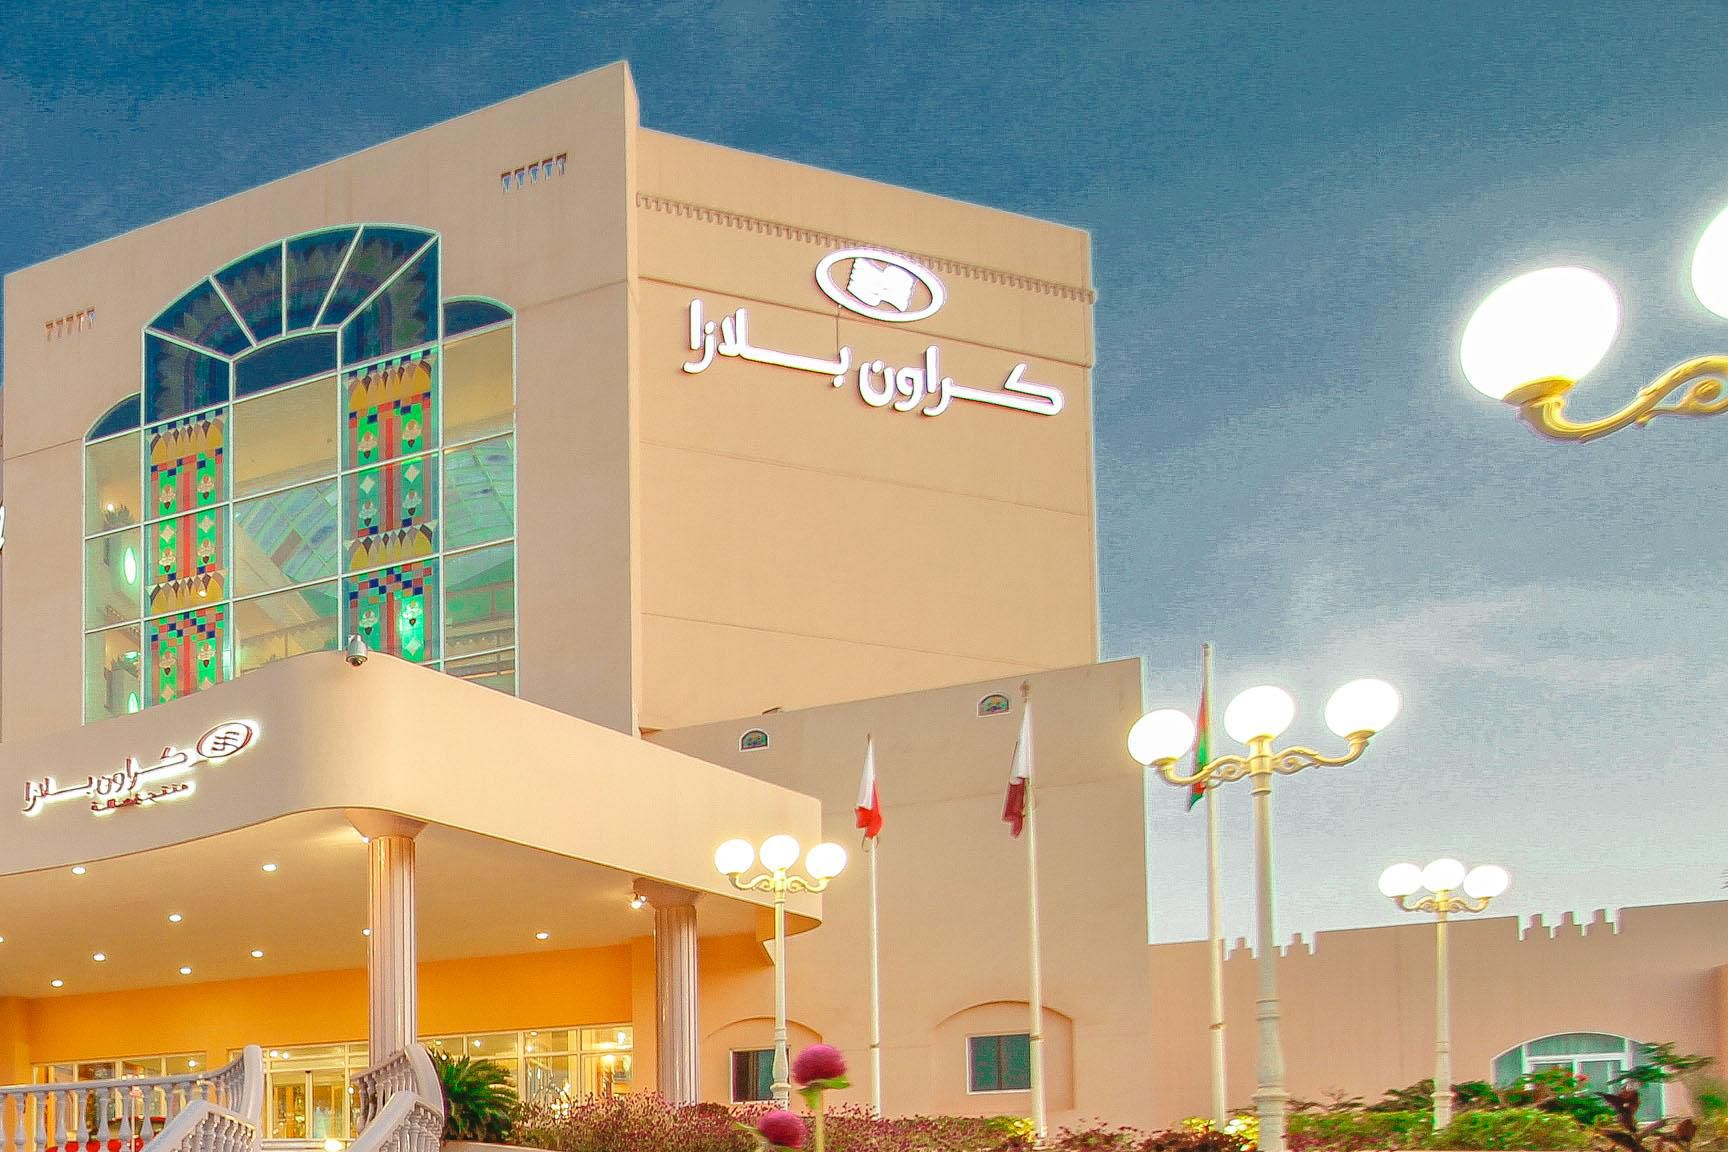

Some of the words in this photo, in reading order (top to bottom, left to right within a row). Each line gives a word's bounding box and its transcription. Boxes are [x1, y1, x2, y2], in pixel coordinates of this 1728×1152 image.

[682, 298, 852, 389] بلازا
[858, 344, 1065, 417] كراون
[22, 776, 94, 812] بلازا
[95, 746, 189, 796] كراون
